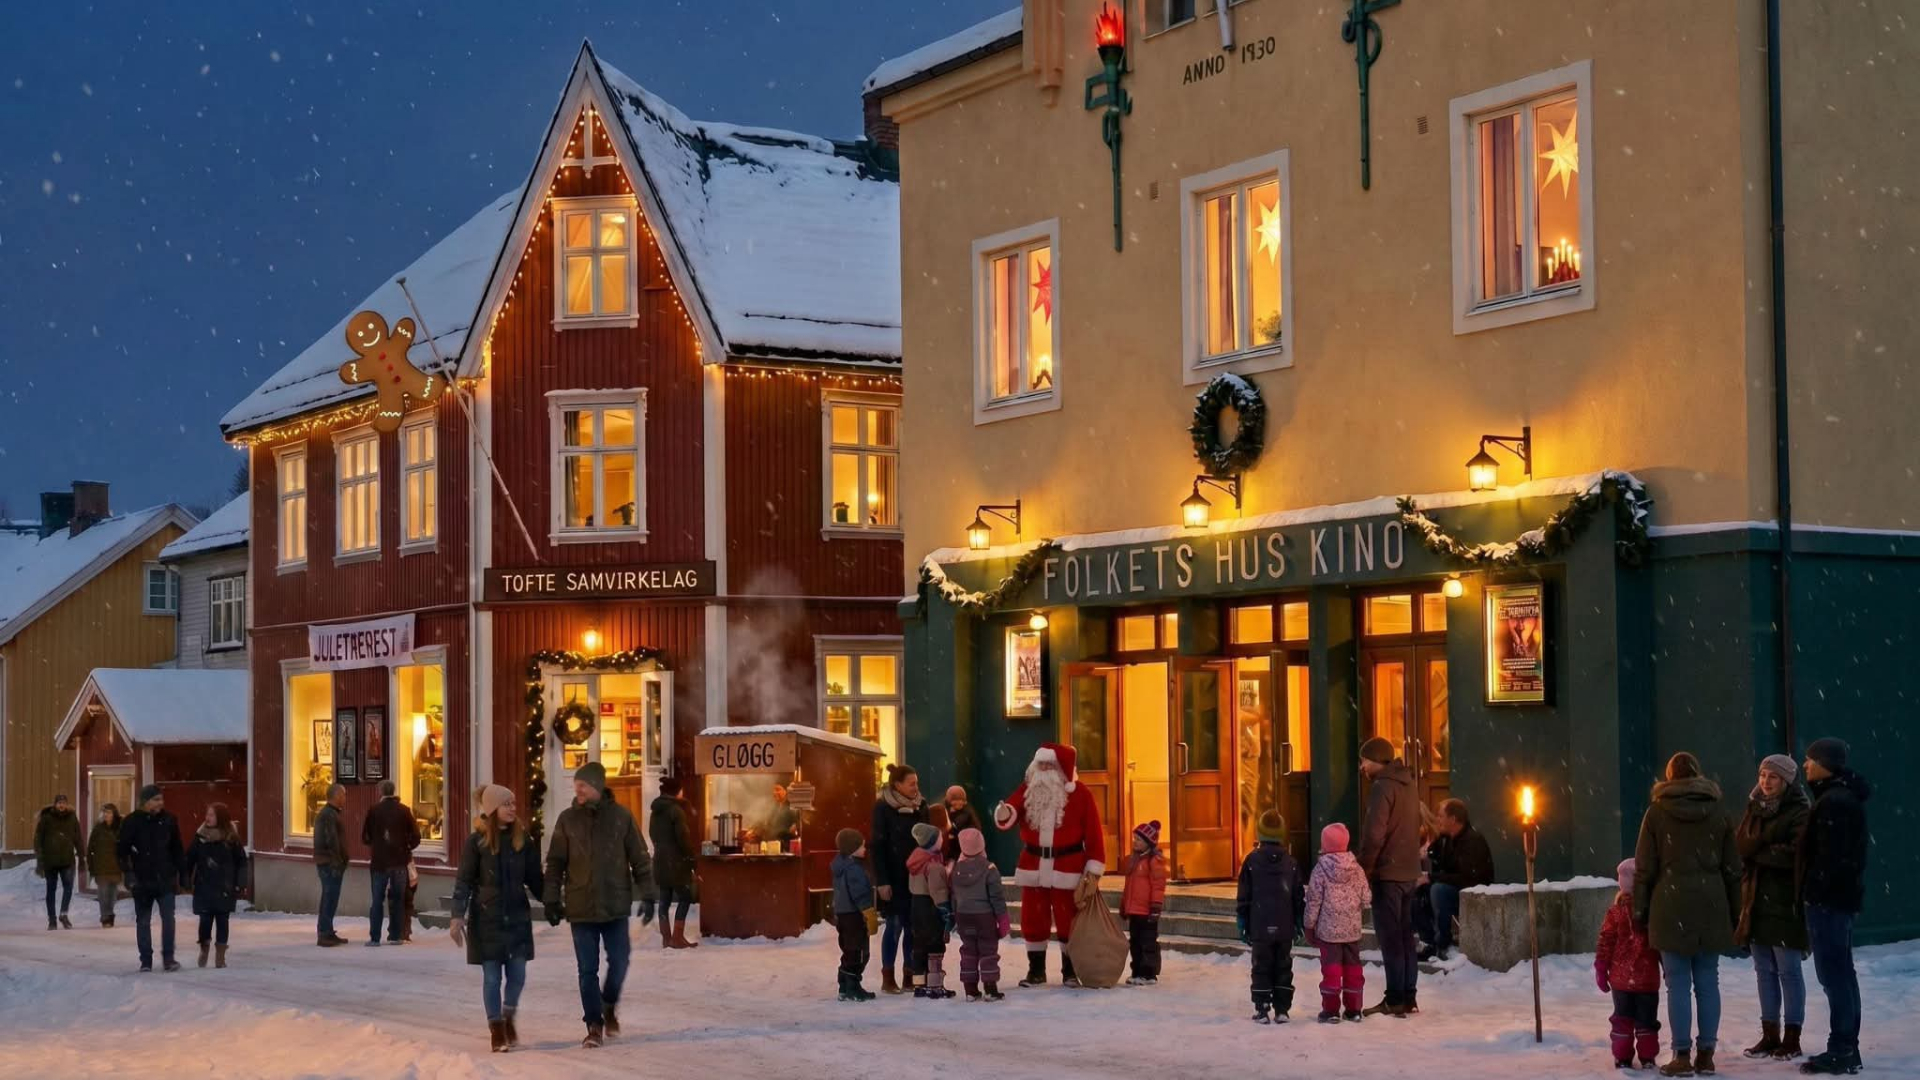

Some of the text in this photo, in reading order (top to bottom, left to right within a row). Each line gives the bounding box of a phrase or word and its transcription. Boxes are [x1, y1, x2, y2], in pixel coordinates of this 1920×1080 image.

[1183, 36, 1275, 85] ANNO 1930
[1044, 520, 1403, 600] FOLKETS HUS KINO
[502, 569, 697, 593] TOFTE SAMVIRKELAG
[713, 742, 774, 769] GLØGG
